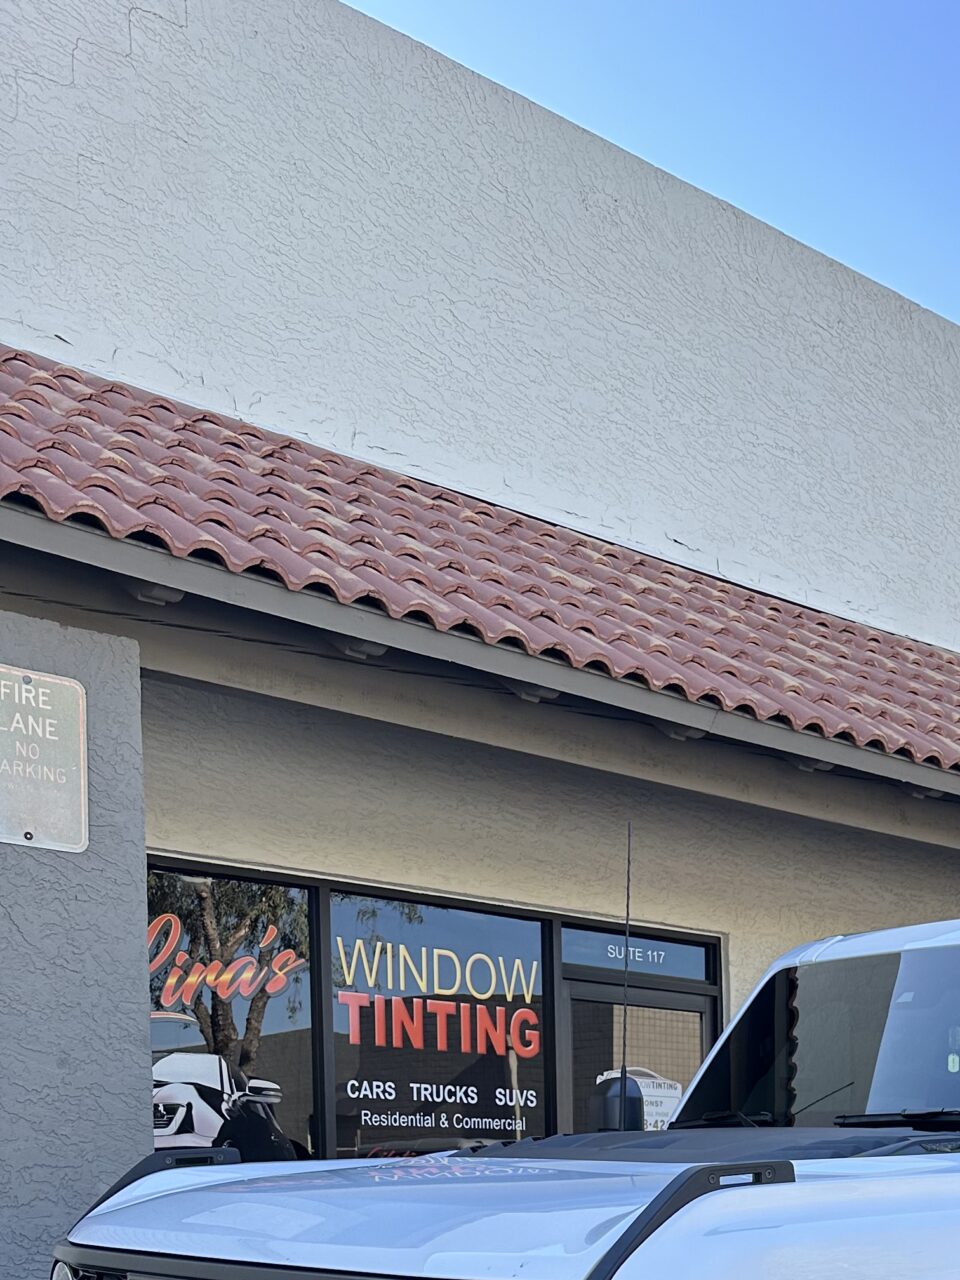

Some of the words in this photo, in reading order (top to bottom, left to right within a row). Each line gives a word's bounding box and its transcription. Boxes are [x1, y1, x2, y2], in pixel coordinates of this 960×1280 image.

[0, 681, 52, 709] FIRE
[16, 741, 40, 760] NO
[0, 759, 66, 784] ARKING
[607, 945, 643, 961] SUTE
[647, 950, 665, 963] 117
[336, 936, 538, 1004] WINDOW
[338, 991, 540, 1059] TINTING
[346, 1079, 396, 1100] CARS
[410, 1083, 478, 1104] TRUCKS
[495, 1088, 537, 1108] SUVS
[361, 1110, 435, 1128] Residential
[439, 1114, 449, 1128] &
[453, 1114, 526, 1131] Commercial
